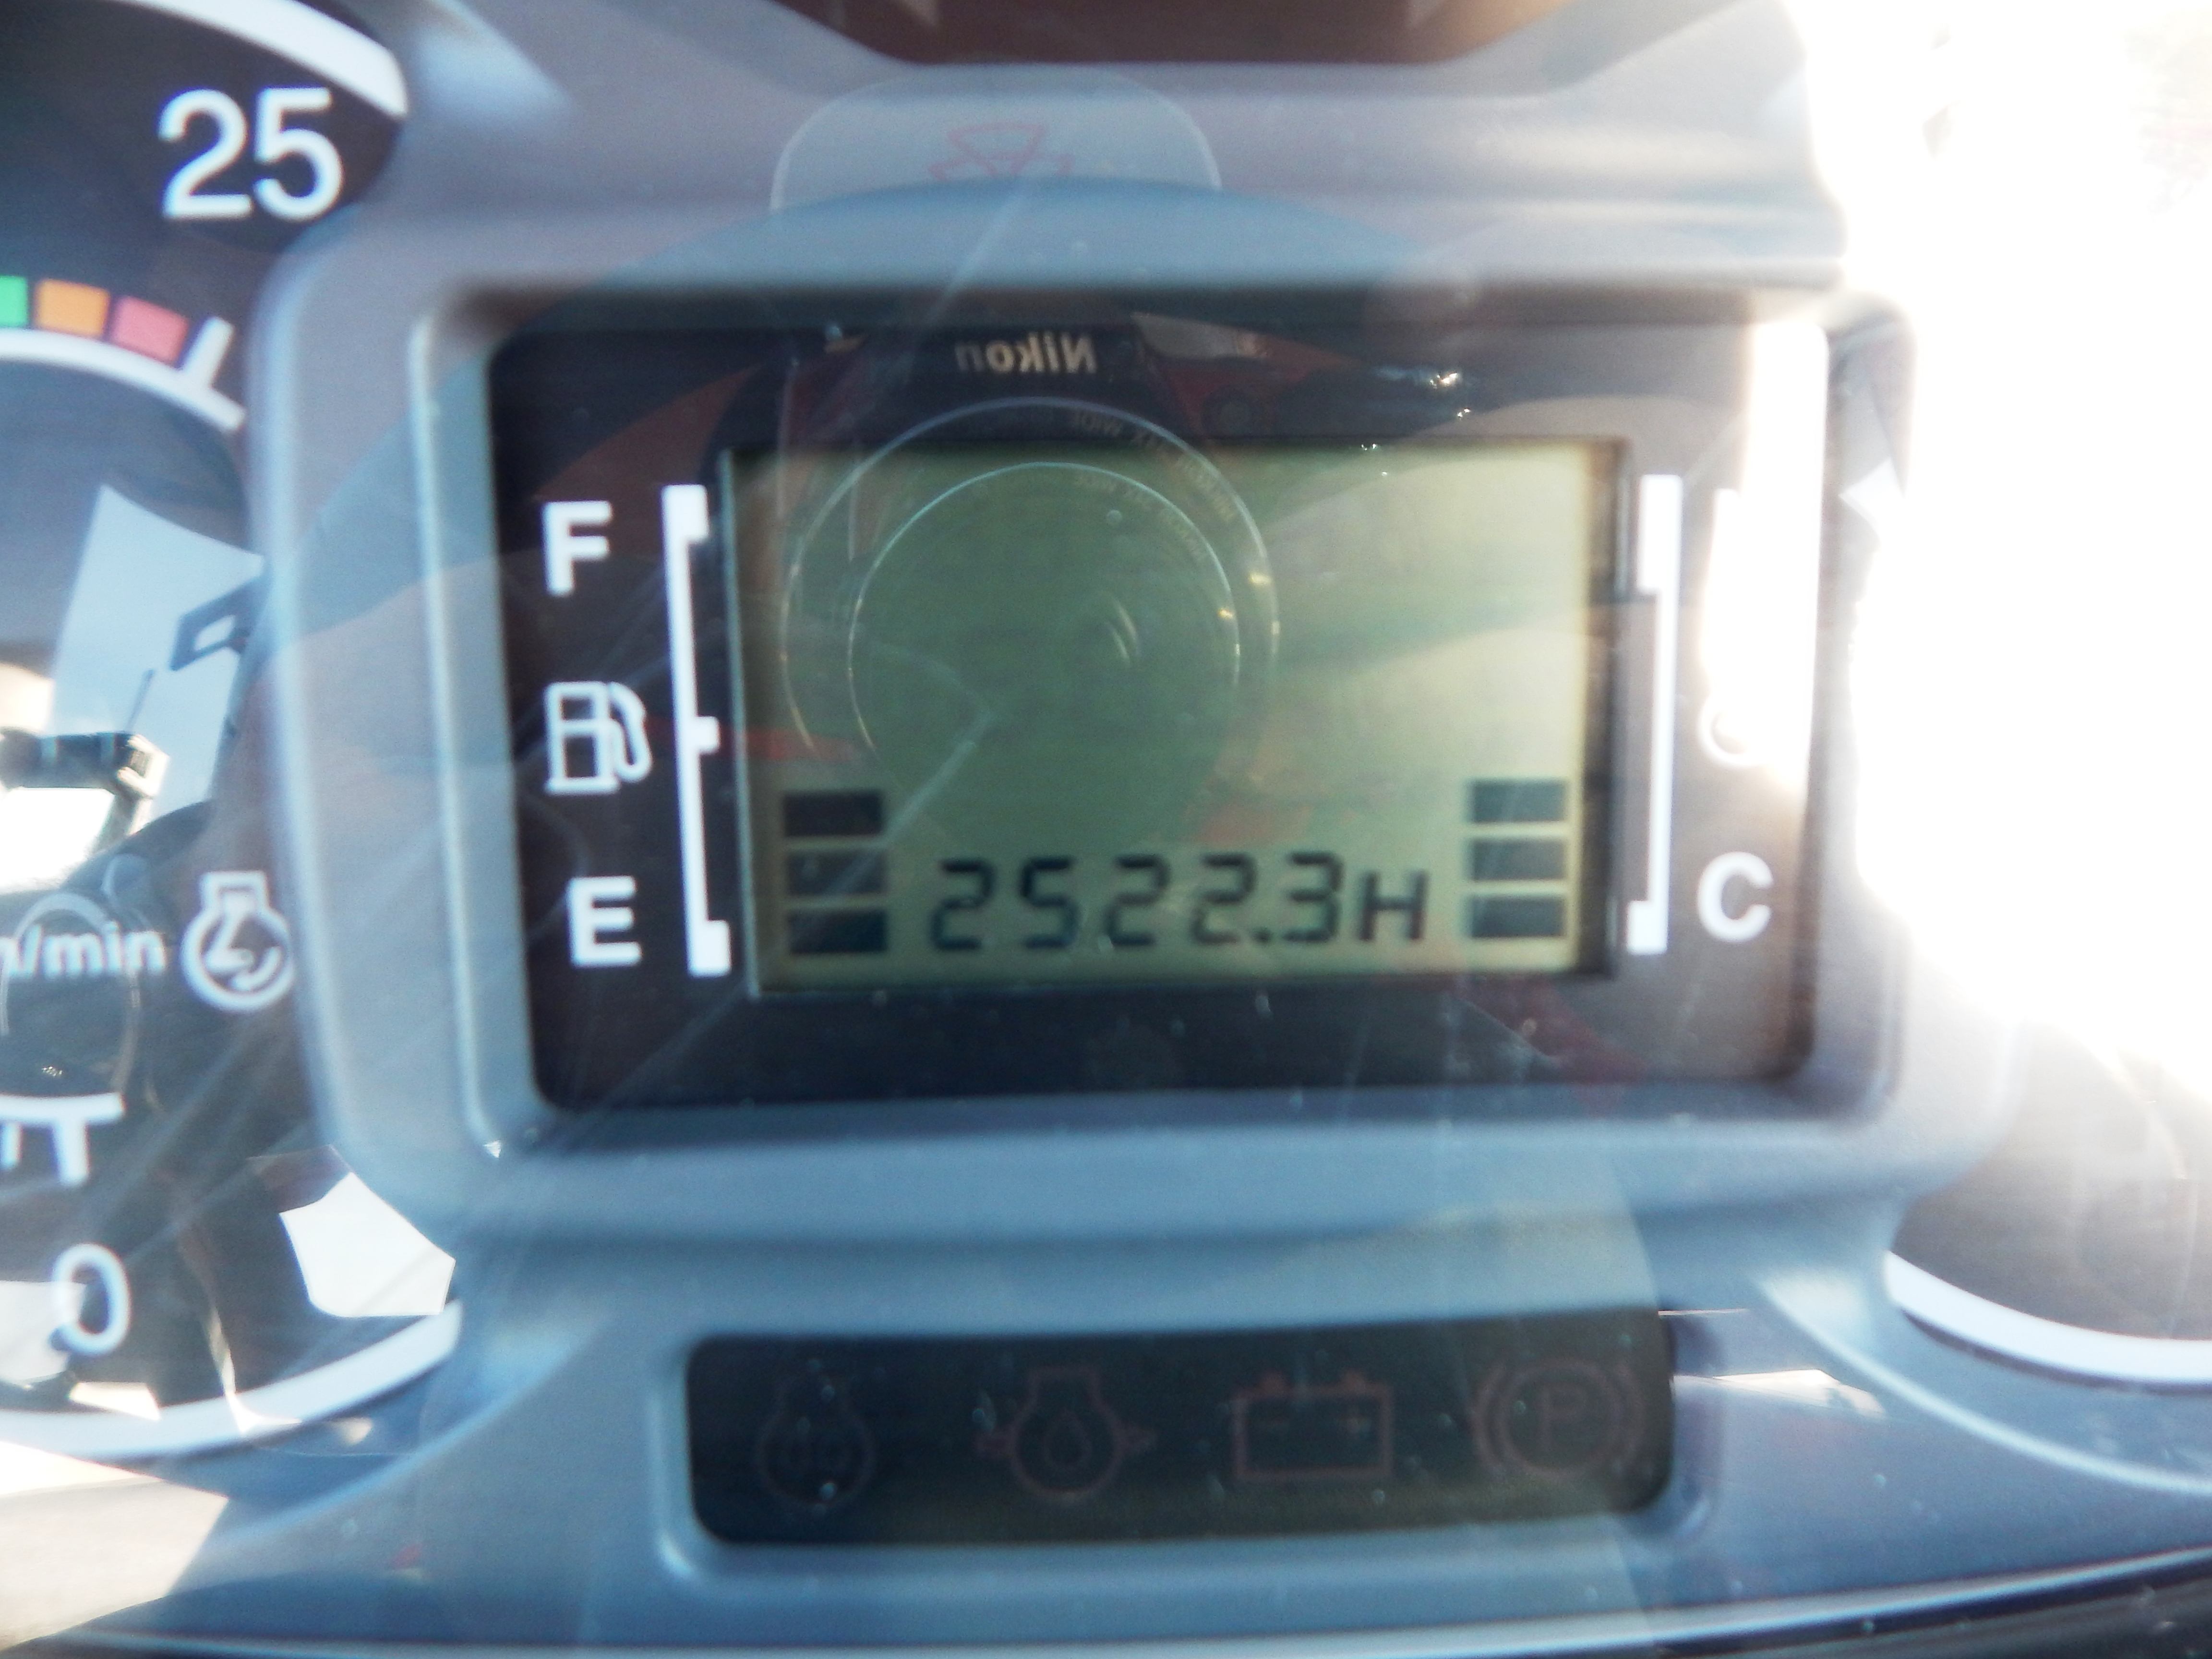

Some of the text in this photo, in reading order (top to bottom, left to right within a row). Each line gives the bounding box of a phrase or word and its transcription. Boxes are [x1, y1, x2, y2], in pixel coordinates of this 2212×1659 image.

[157, 86, 344, 221] 25
[542, 500, 613, 597] F
[566, 875, 642, 967] E
[1697, 851, 1774, 942] C
